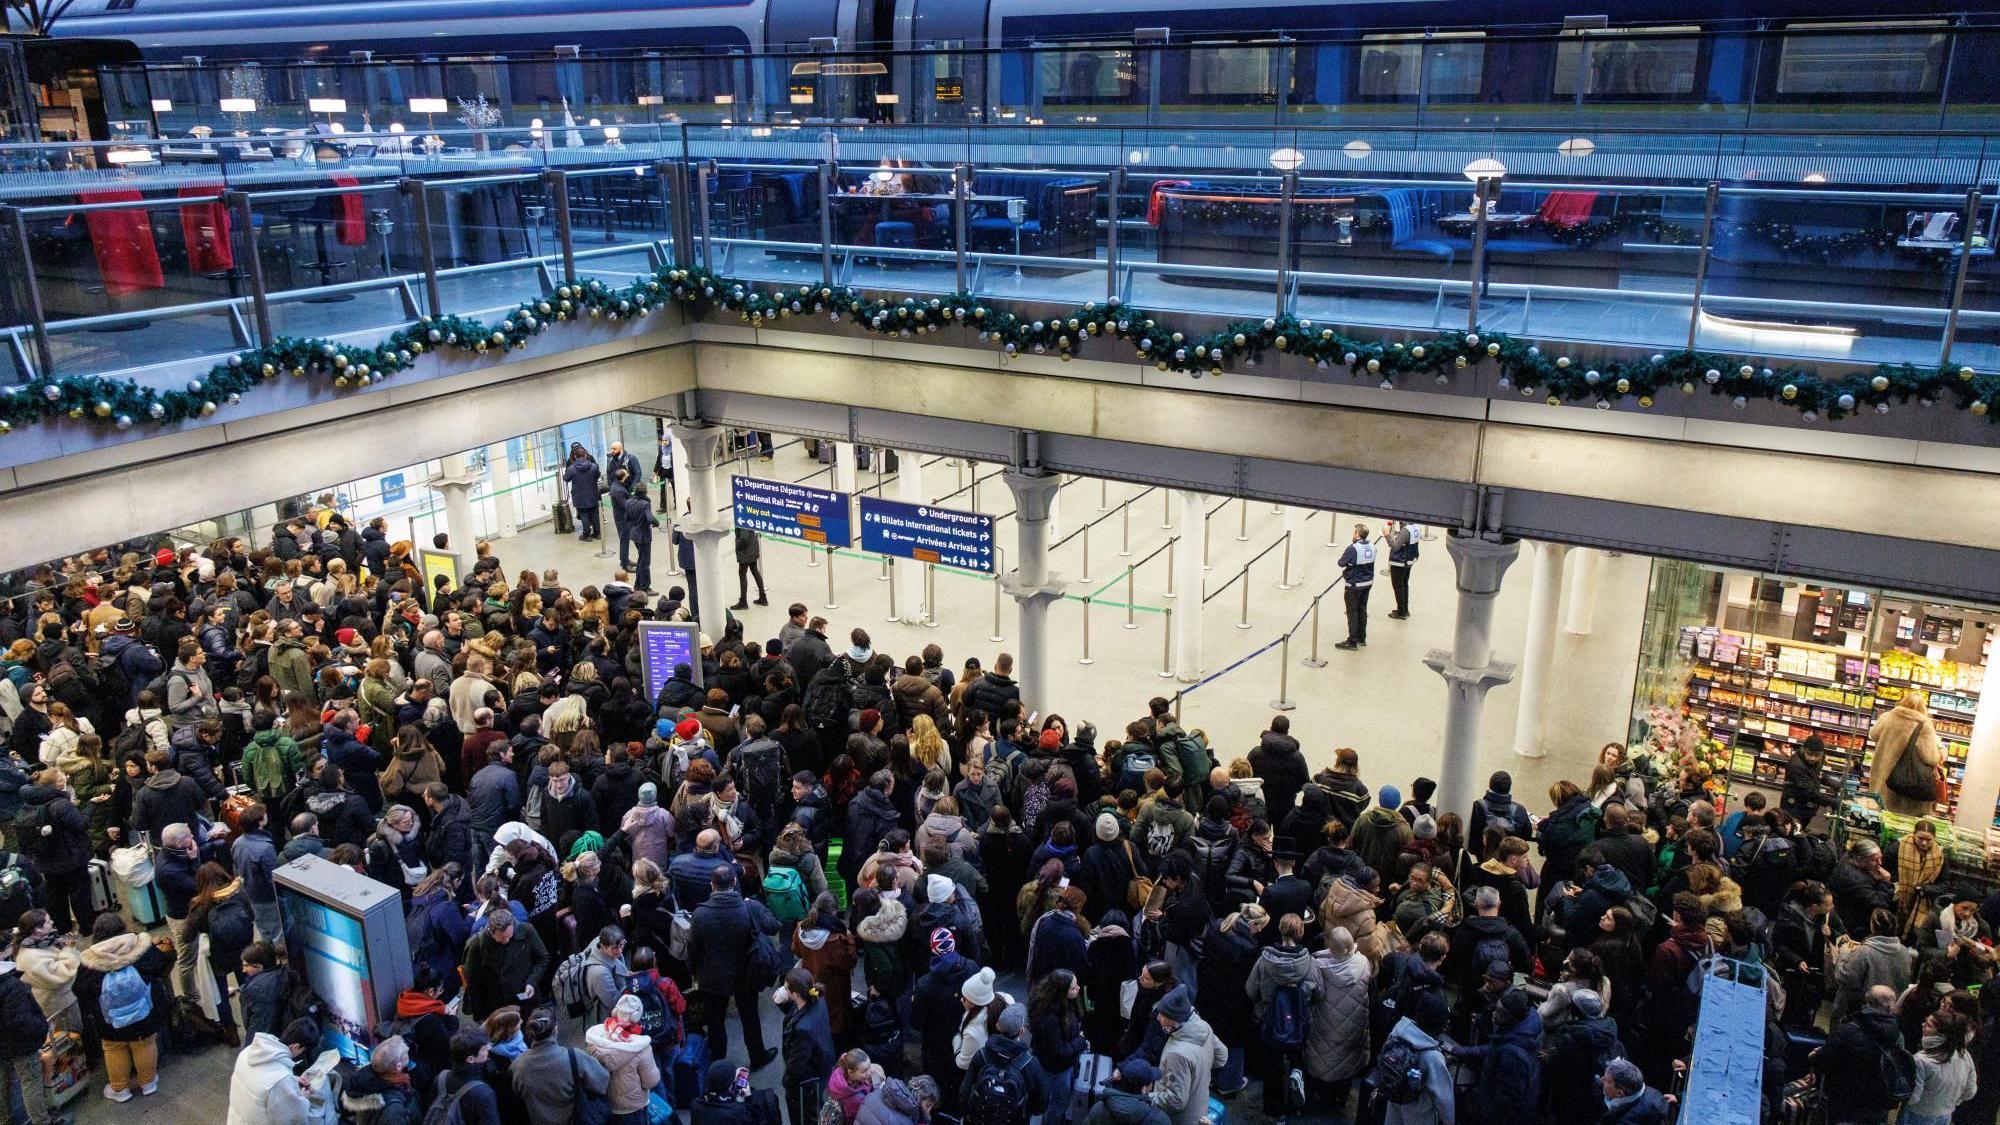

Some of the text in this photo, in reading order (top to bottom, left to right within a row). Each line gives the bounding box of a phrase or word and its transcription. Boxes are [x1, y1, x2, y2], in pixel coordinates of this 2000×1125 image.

[745, 480, 779, 492] Departures
[780, 486, 805, 496] Départs
[745, 493, 784, 506] National Rail
[746, 506, 759, 515] Way
[760, 509, 771, 517] out
[929, 510, 978, 524] Underground
[881, 516, 978, 539] Billets International tickets
[917, 536, 947, 548] Arrivées
[948, 541, 978, 553] Arrivals
